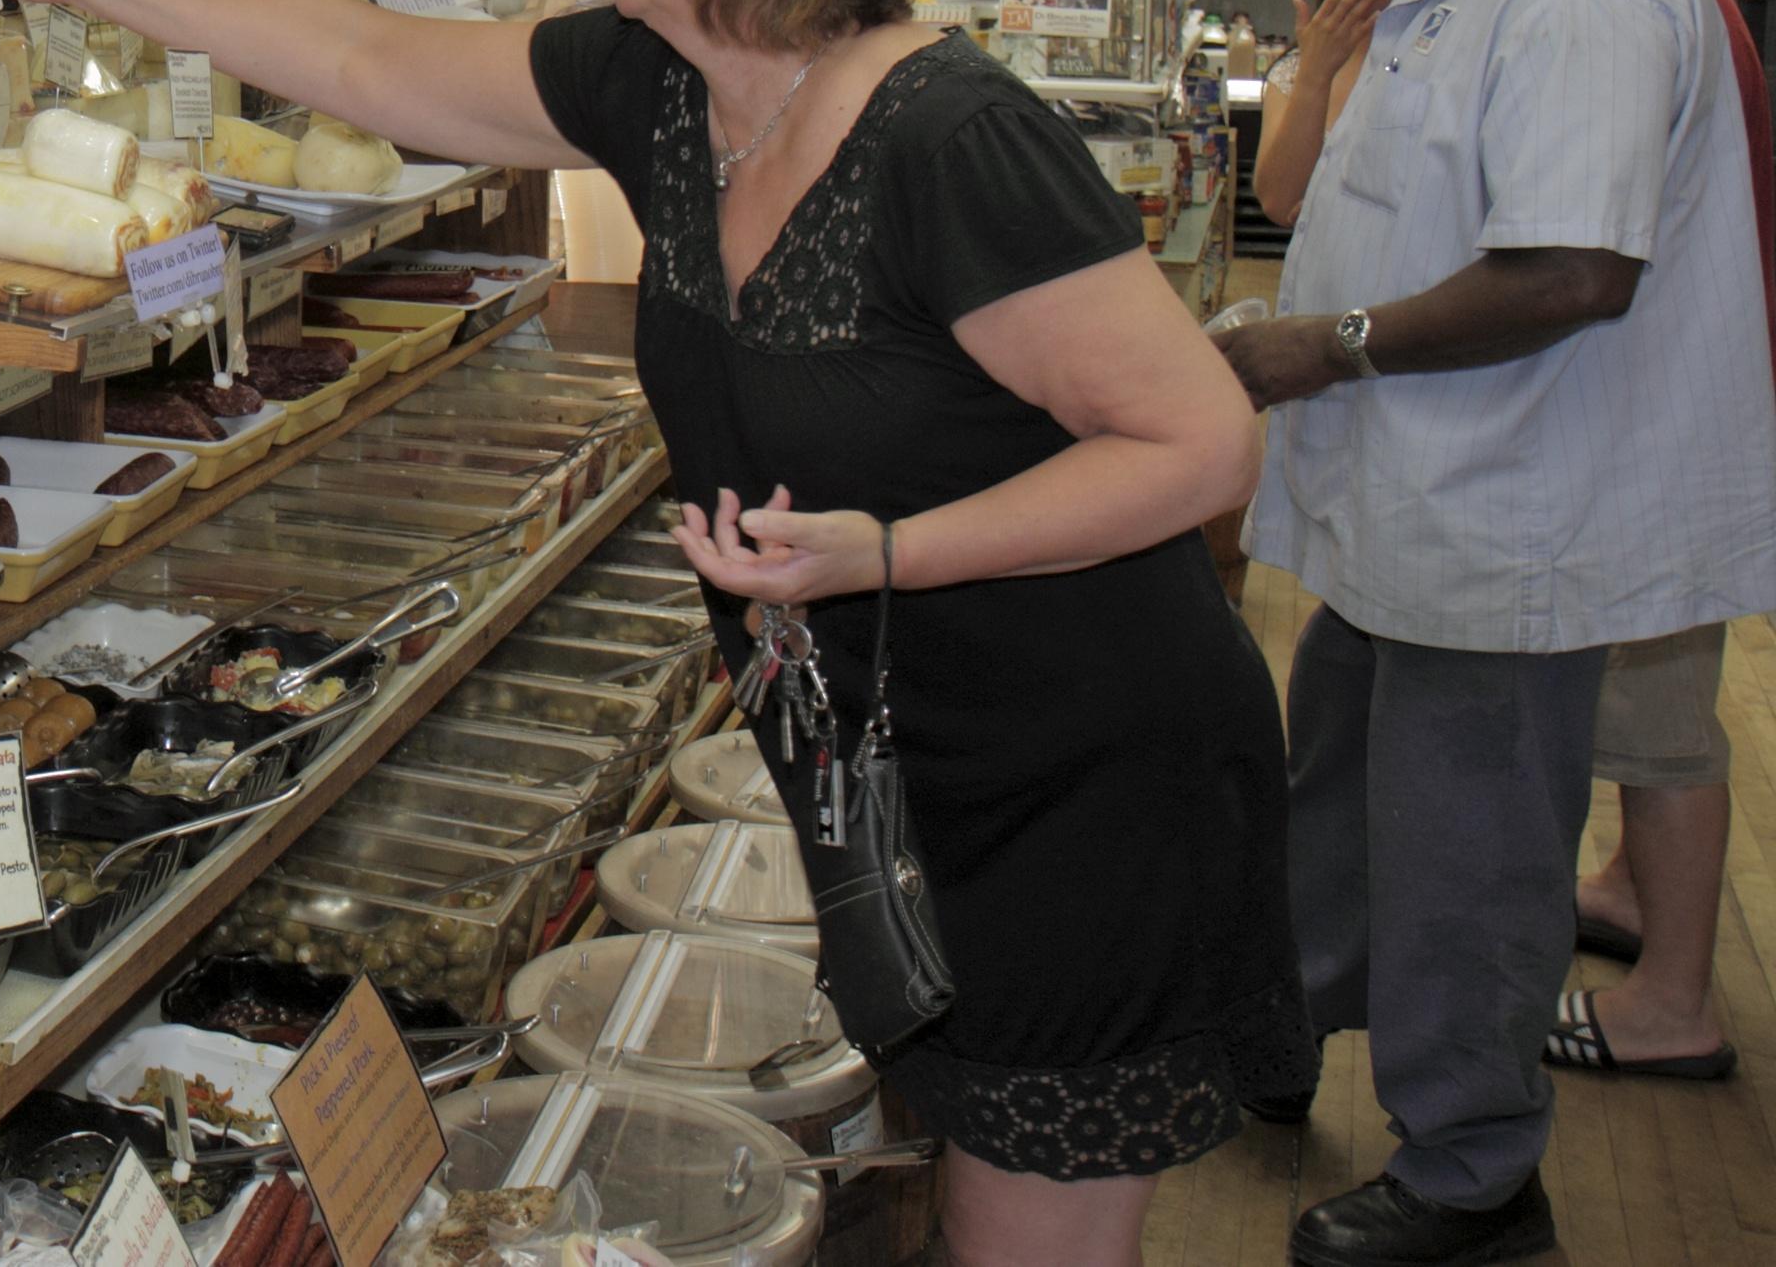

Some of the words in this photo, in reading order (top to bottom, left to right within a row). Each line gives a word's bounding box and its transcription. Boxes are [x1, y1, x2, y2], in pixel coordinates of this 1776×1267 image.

[130, 258, 163, 281] Follow
[164, 254, 176, 269] us
[177, 250, 188, 264] on
[187, 234, 220, 260] Twitter!
[13, 787, 18, 795] a
[313, 1070, 357, 1126] Peppered
[352, 1042, 375, 1079] Pork
